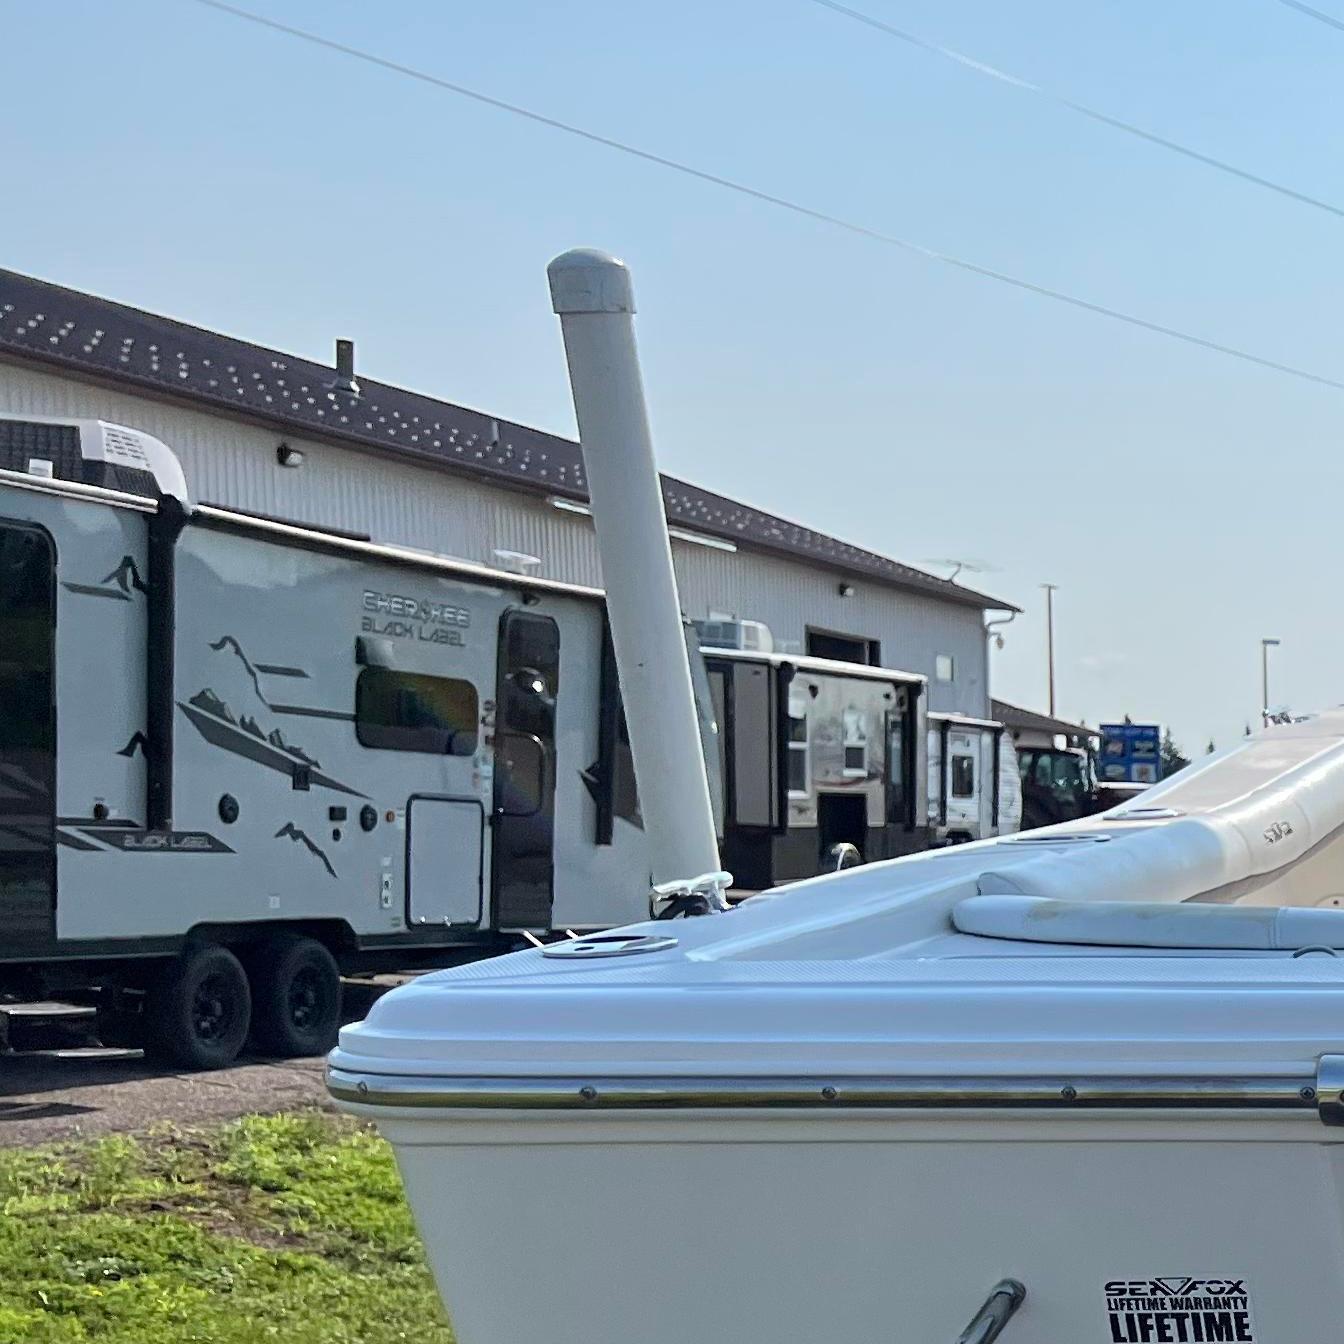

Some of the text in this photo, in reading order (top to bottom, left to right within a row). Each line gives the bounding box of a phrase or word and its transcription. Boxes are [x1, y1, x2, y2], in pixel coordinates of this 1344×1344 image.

[361, 616, 466, 647] BLACK LABEL
[1107, 1296, 1249, 1311] LIFETIME WARRANTY
[1109, 1312, 1253, 1343] LIFETIME
